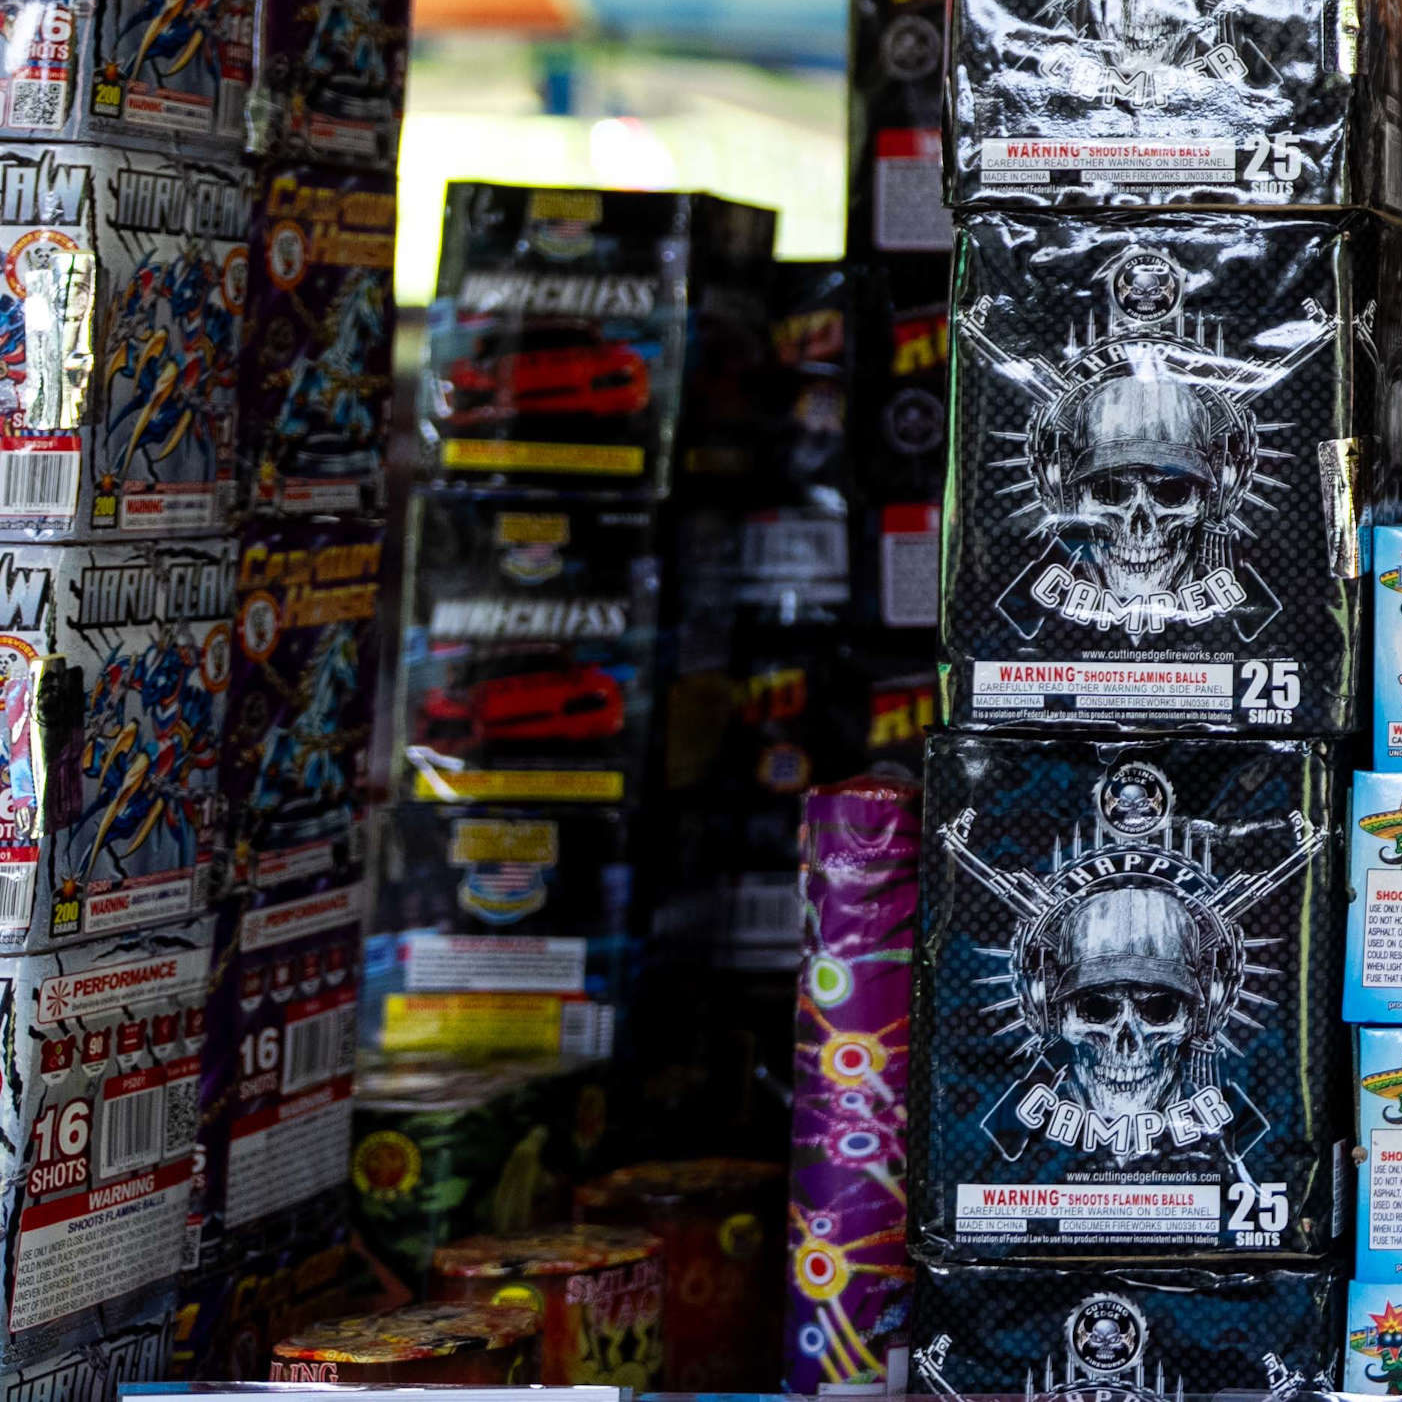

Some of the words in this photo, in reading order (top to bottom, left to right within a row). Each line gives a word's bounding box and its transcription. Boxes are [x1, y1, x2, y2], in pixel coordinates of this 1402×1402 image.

[1244, 133, 1301, 179] 25
[83, 568, 157, 628] HARD
[1031, 564, 1247, 636] CAMPER
[1082, 649, 1235, 662] www.cuttingedgefireworks.com
[1241, 662, 1299, 709] 25
[1249, 709, 1293, 724] SHOTS
[1069, 853, 1196, 893] HAPPY
[73, 960, 177, 997] PERFORMANCE
[241, 1027, 280, 1075] 16
[35, 1100, 90, 1162] 16
[1014, 1083, 1235, 1155] CAMPER
[31, 1159, 87, 1194] SHOTS
[89, 1176, 155, 1210] WARNING
[1067, 1170, 1221, 1185] www.cuttingedgefireworks.com
[1069, 1195, 1109, 1205] SHOOTS
[1113, 1195, 1158, 1206] FLAMING
[1162, 1194, 1194, 1205] BALLS
[1228, 1183, 1288, 1231] 25
[959, 1221, 984, 1231] MADE
[986, 1221, 995, 1231] IN
[997, 1221, 1024, 1231] CHINA
[1236, 1232, 1280, 1246] SHOTS
